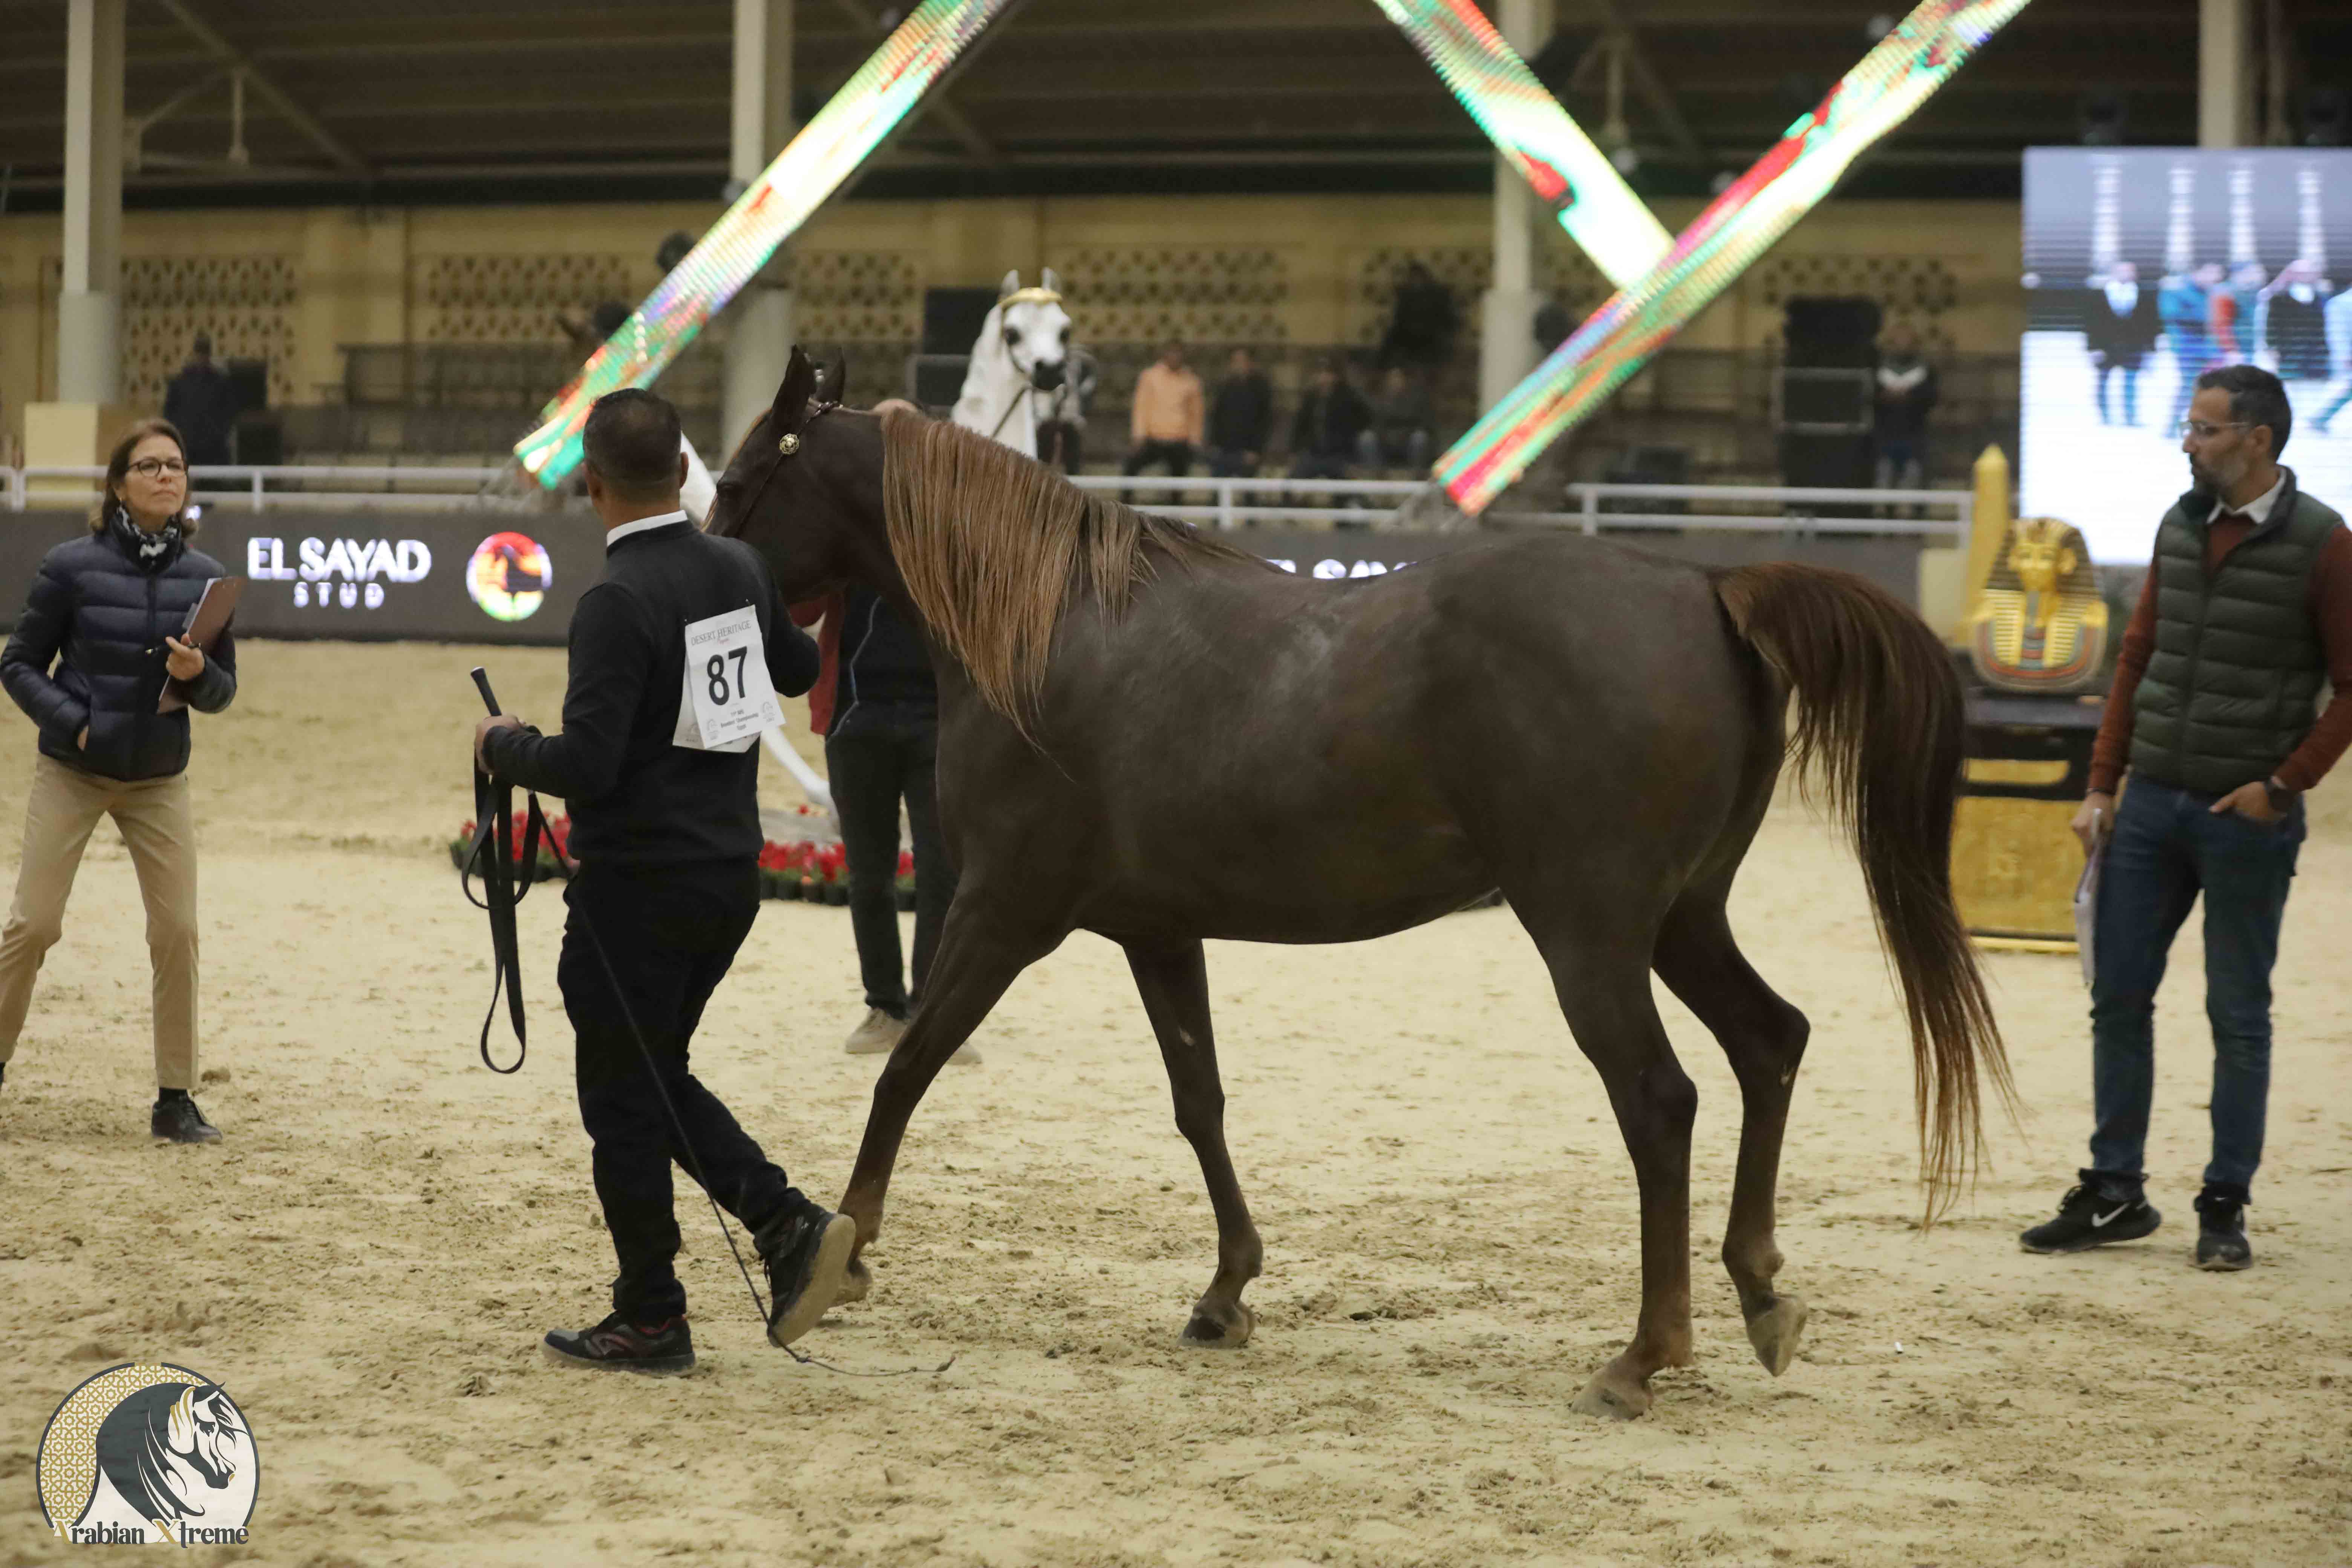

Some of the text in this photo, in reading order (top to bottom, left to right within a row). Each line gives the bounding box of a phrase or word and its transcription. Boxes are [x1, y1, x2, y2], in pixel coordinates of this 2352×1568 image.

[248, 537, 432, 583] EL SAYAD
[294, 582, 384, 609] STUD
[691, 620, 751, 646] DESERT HERITAGE
[707, 646, 747, 706] 87
